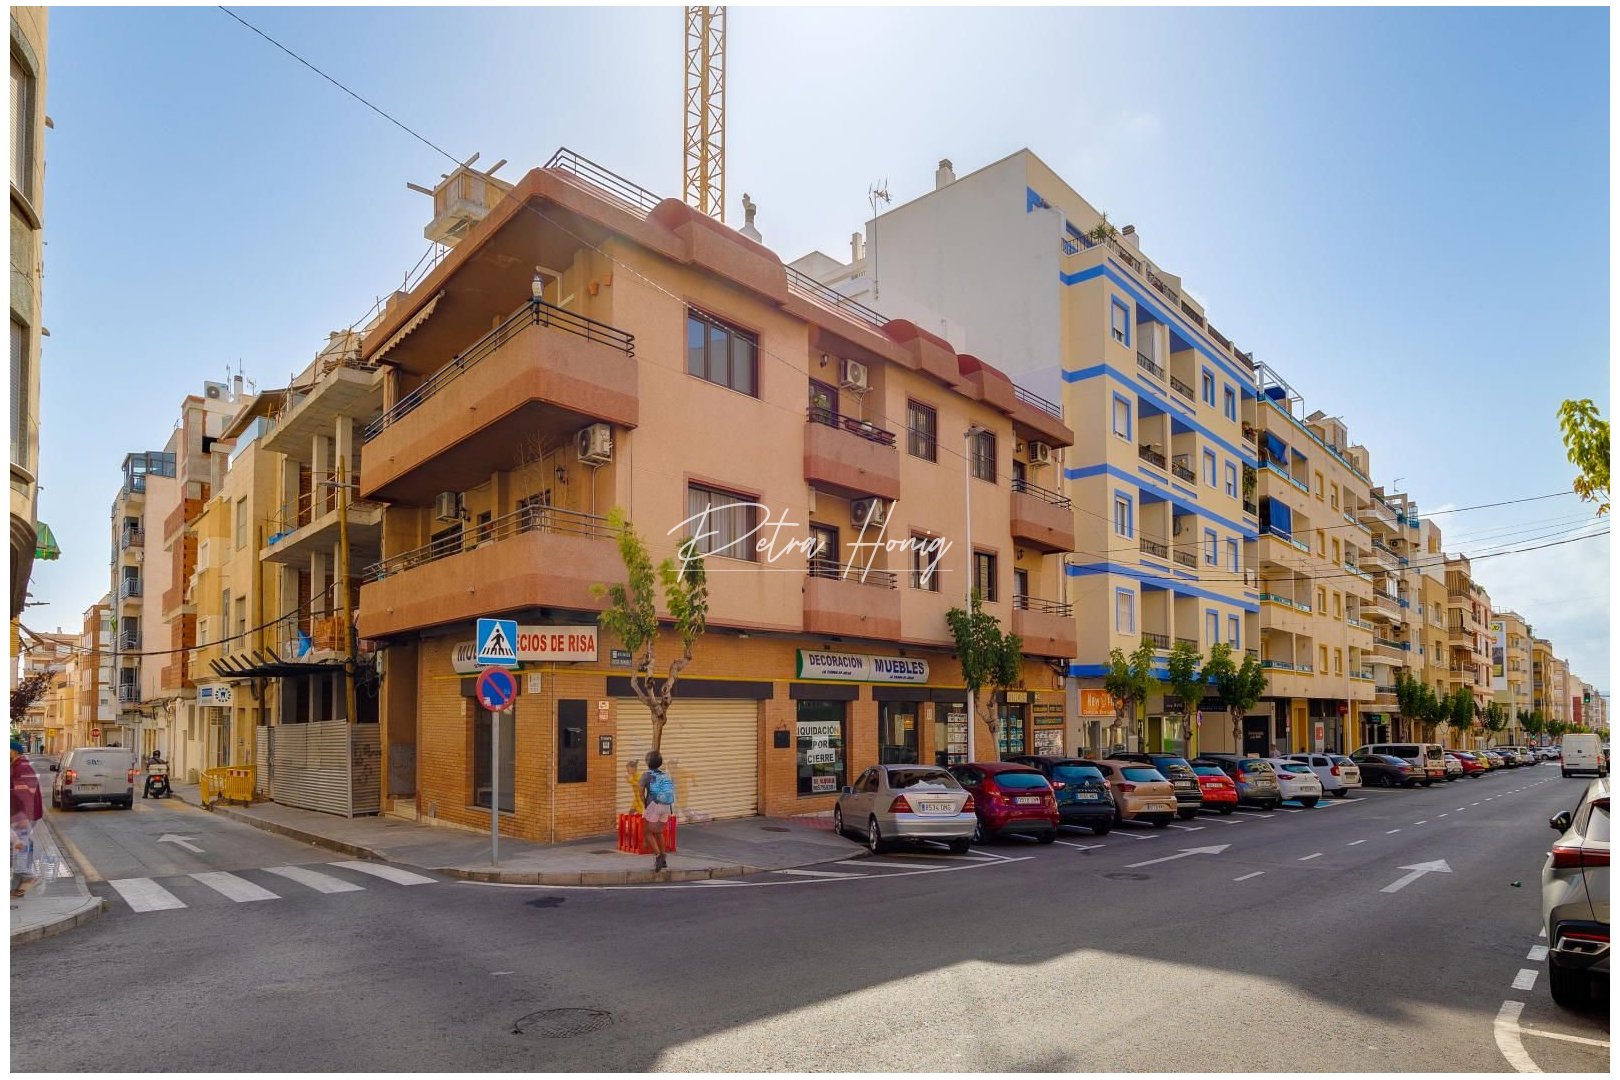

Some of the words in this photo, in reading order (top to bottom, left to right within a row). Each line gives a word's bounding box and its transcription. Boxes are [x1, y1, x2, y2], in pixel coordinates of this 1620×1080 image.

[551, 634, 565, 652] DE
[568, 634, 595, 652] RISA
[874, 658, 925, 675] MUEBLES
[812, 740, 828, 749] POR
[807, 753, 834, 764] CIERRE
